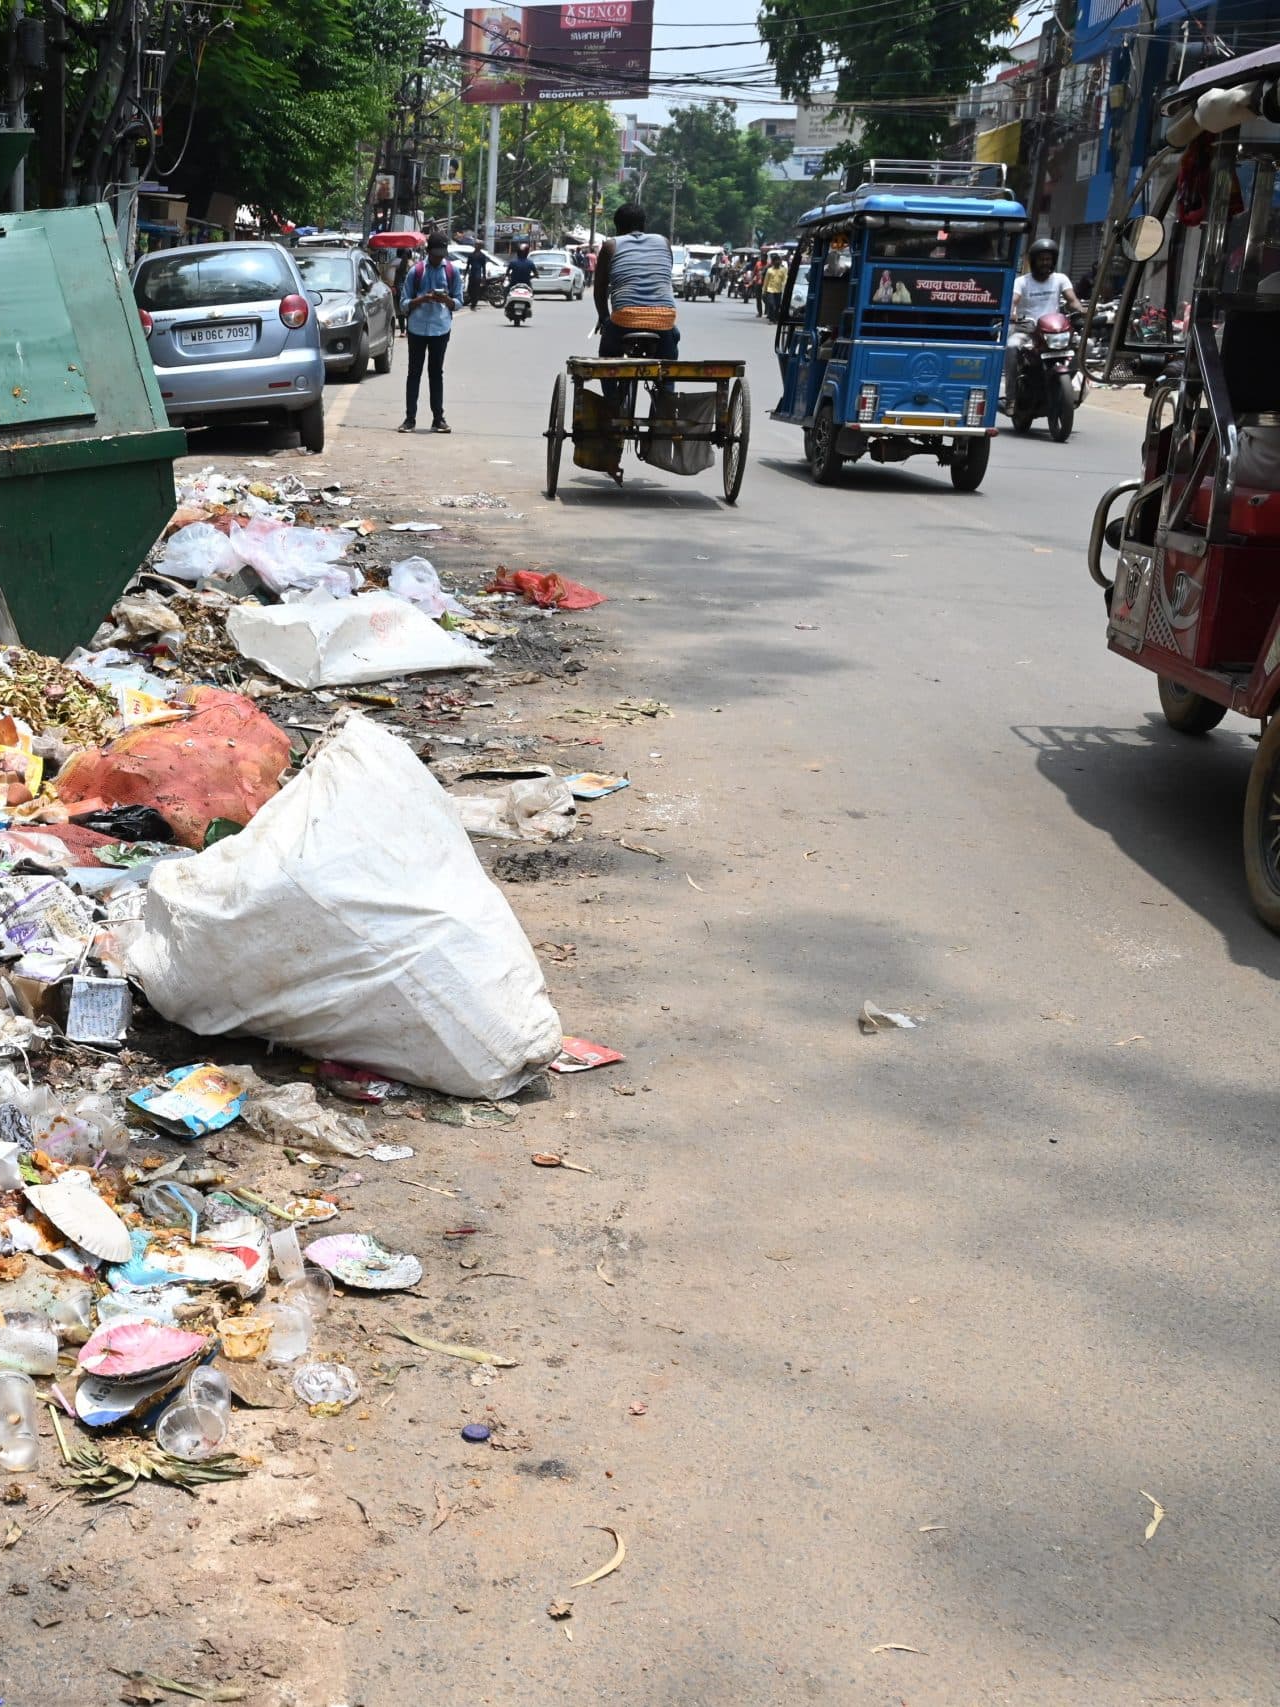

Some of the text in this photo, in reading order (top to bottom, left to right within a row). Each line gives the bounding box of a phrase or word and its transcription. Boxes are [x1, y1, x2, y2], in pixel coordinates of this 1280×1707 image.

[577, 4, 627, 17] SENCO
[916, 280, 943, 290] ज्यादा
[930, 291, 958, 302] ज्यादा
[191, 326, 250, 342] WB 06C 7092
